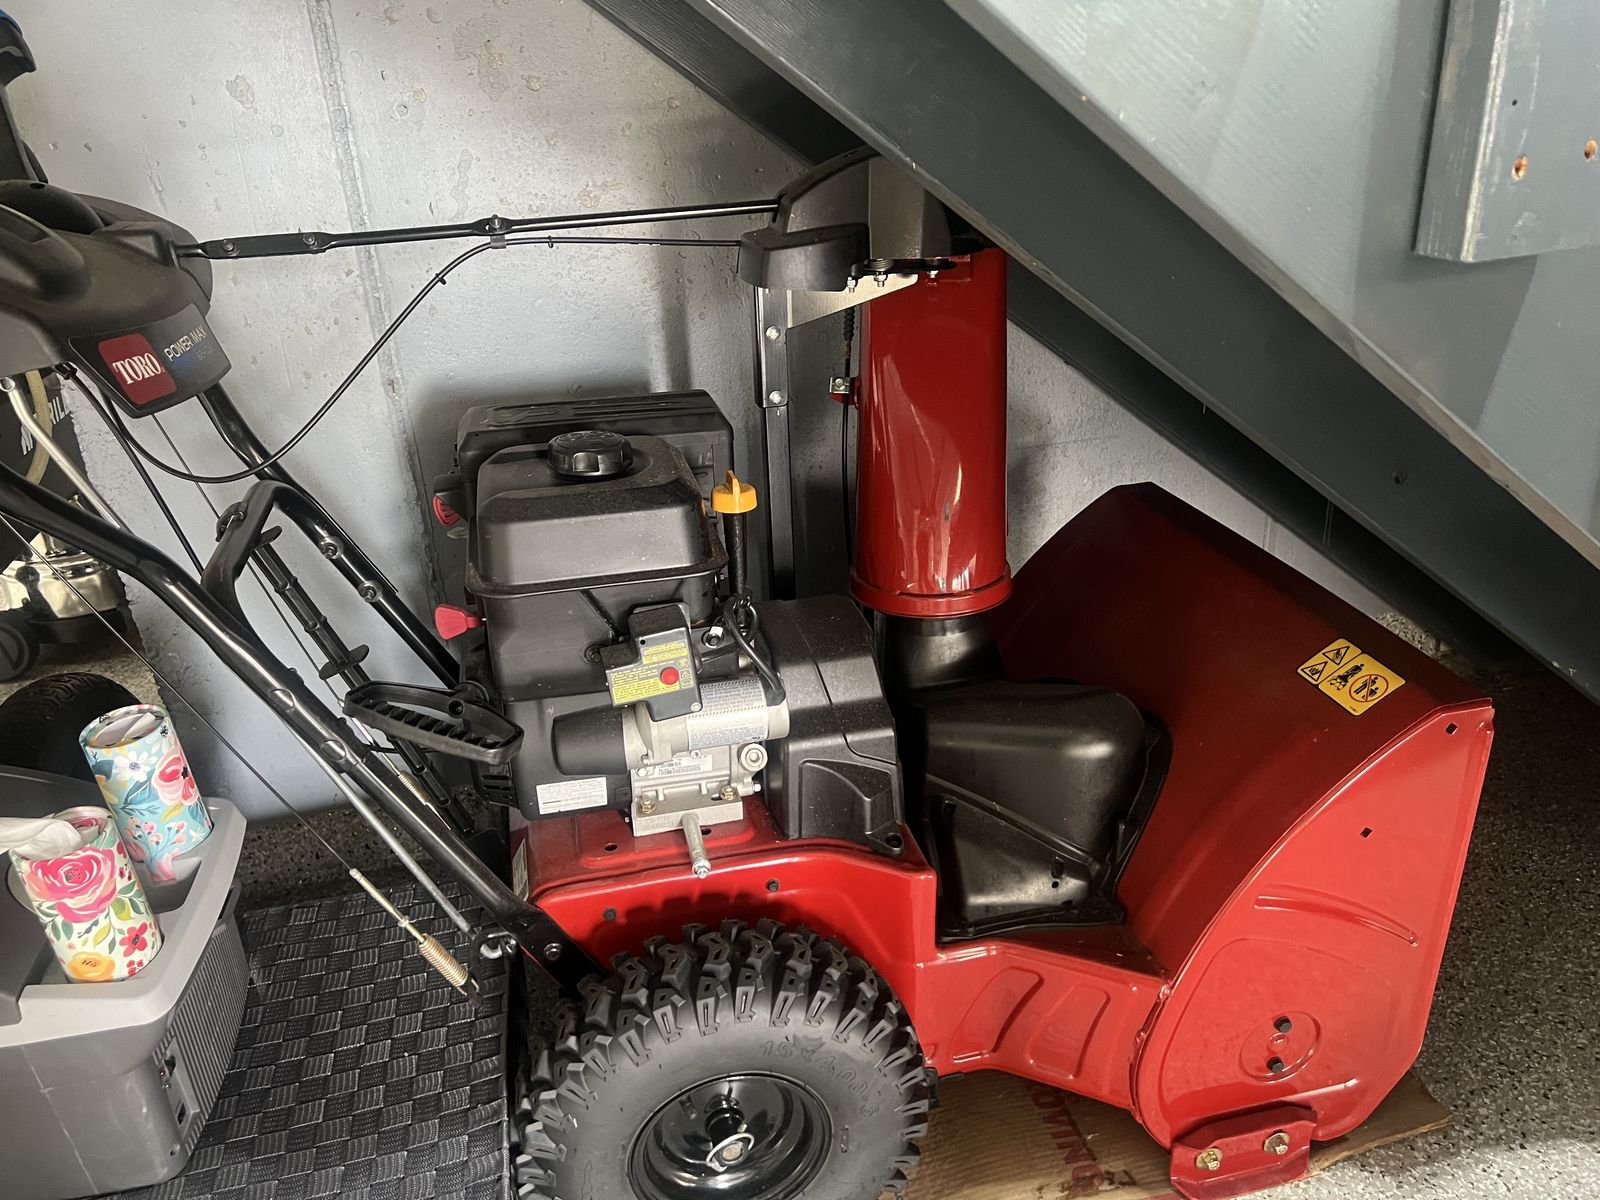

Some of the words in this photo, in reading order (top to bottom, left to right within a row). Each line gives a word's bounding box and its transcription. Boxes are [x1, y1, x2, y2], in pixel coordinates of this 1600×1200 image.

[163, 335, 194, 362] POWER
[190, 325, 208, 343] MAX
[112, 352, 162, 385] TORO
